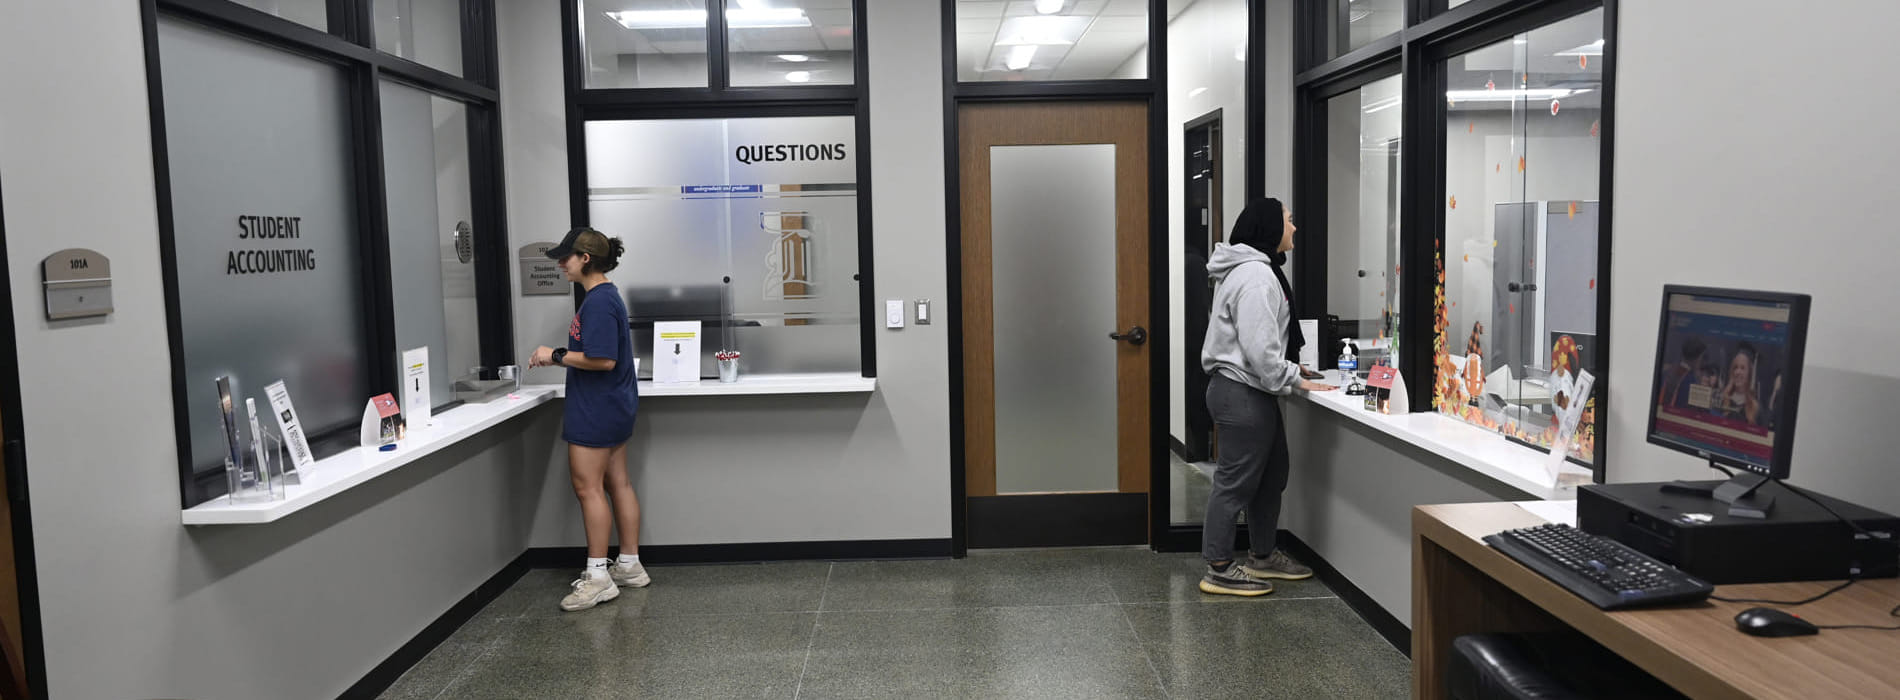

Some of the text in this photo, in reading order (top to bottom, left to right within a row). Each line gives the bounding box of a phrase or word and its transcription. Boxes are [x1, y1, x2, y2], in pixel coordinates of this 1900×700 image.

[736, 143, 846, 165] QUESTIONS
[238, 215, 301, 239] STUDENT
[70, 258, 88, 269] 101A
[227, 249, 316, 275] ACCOUNTING
